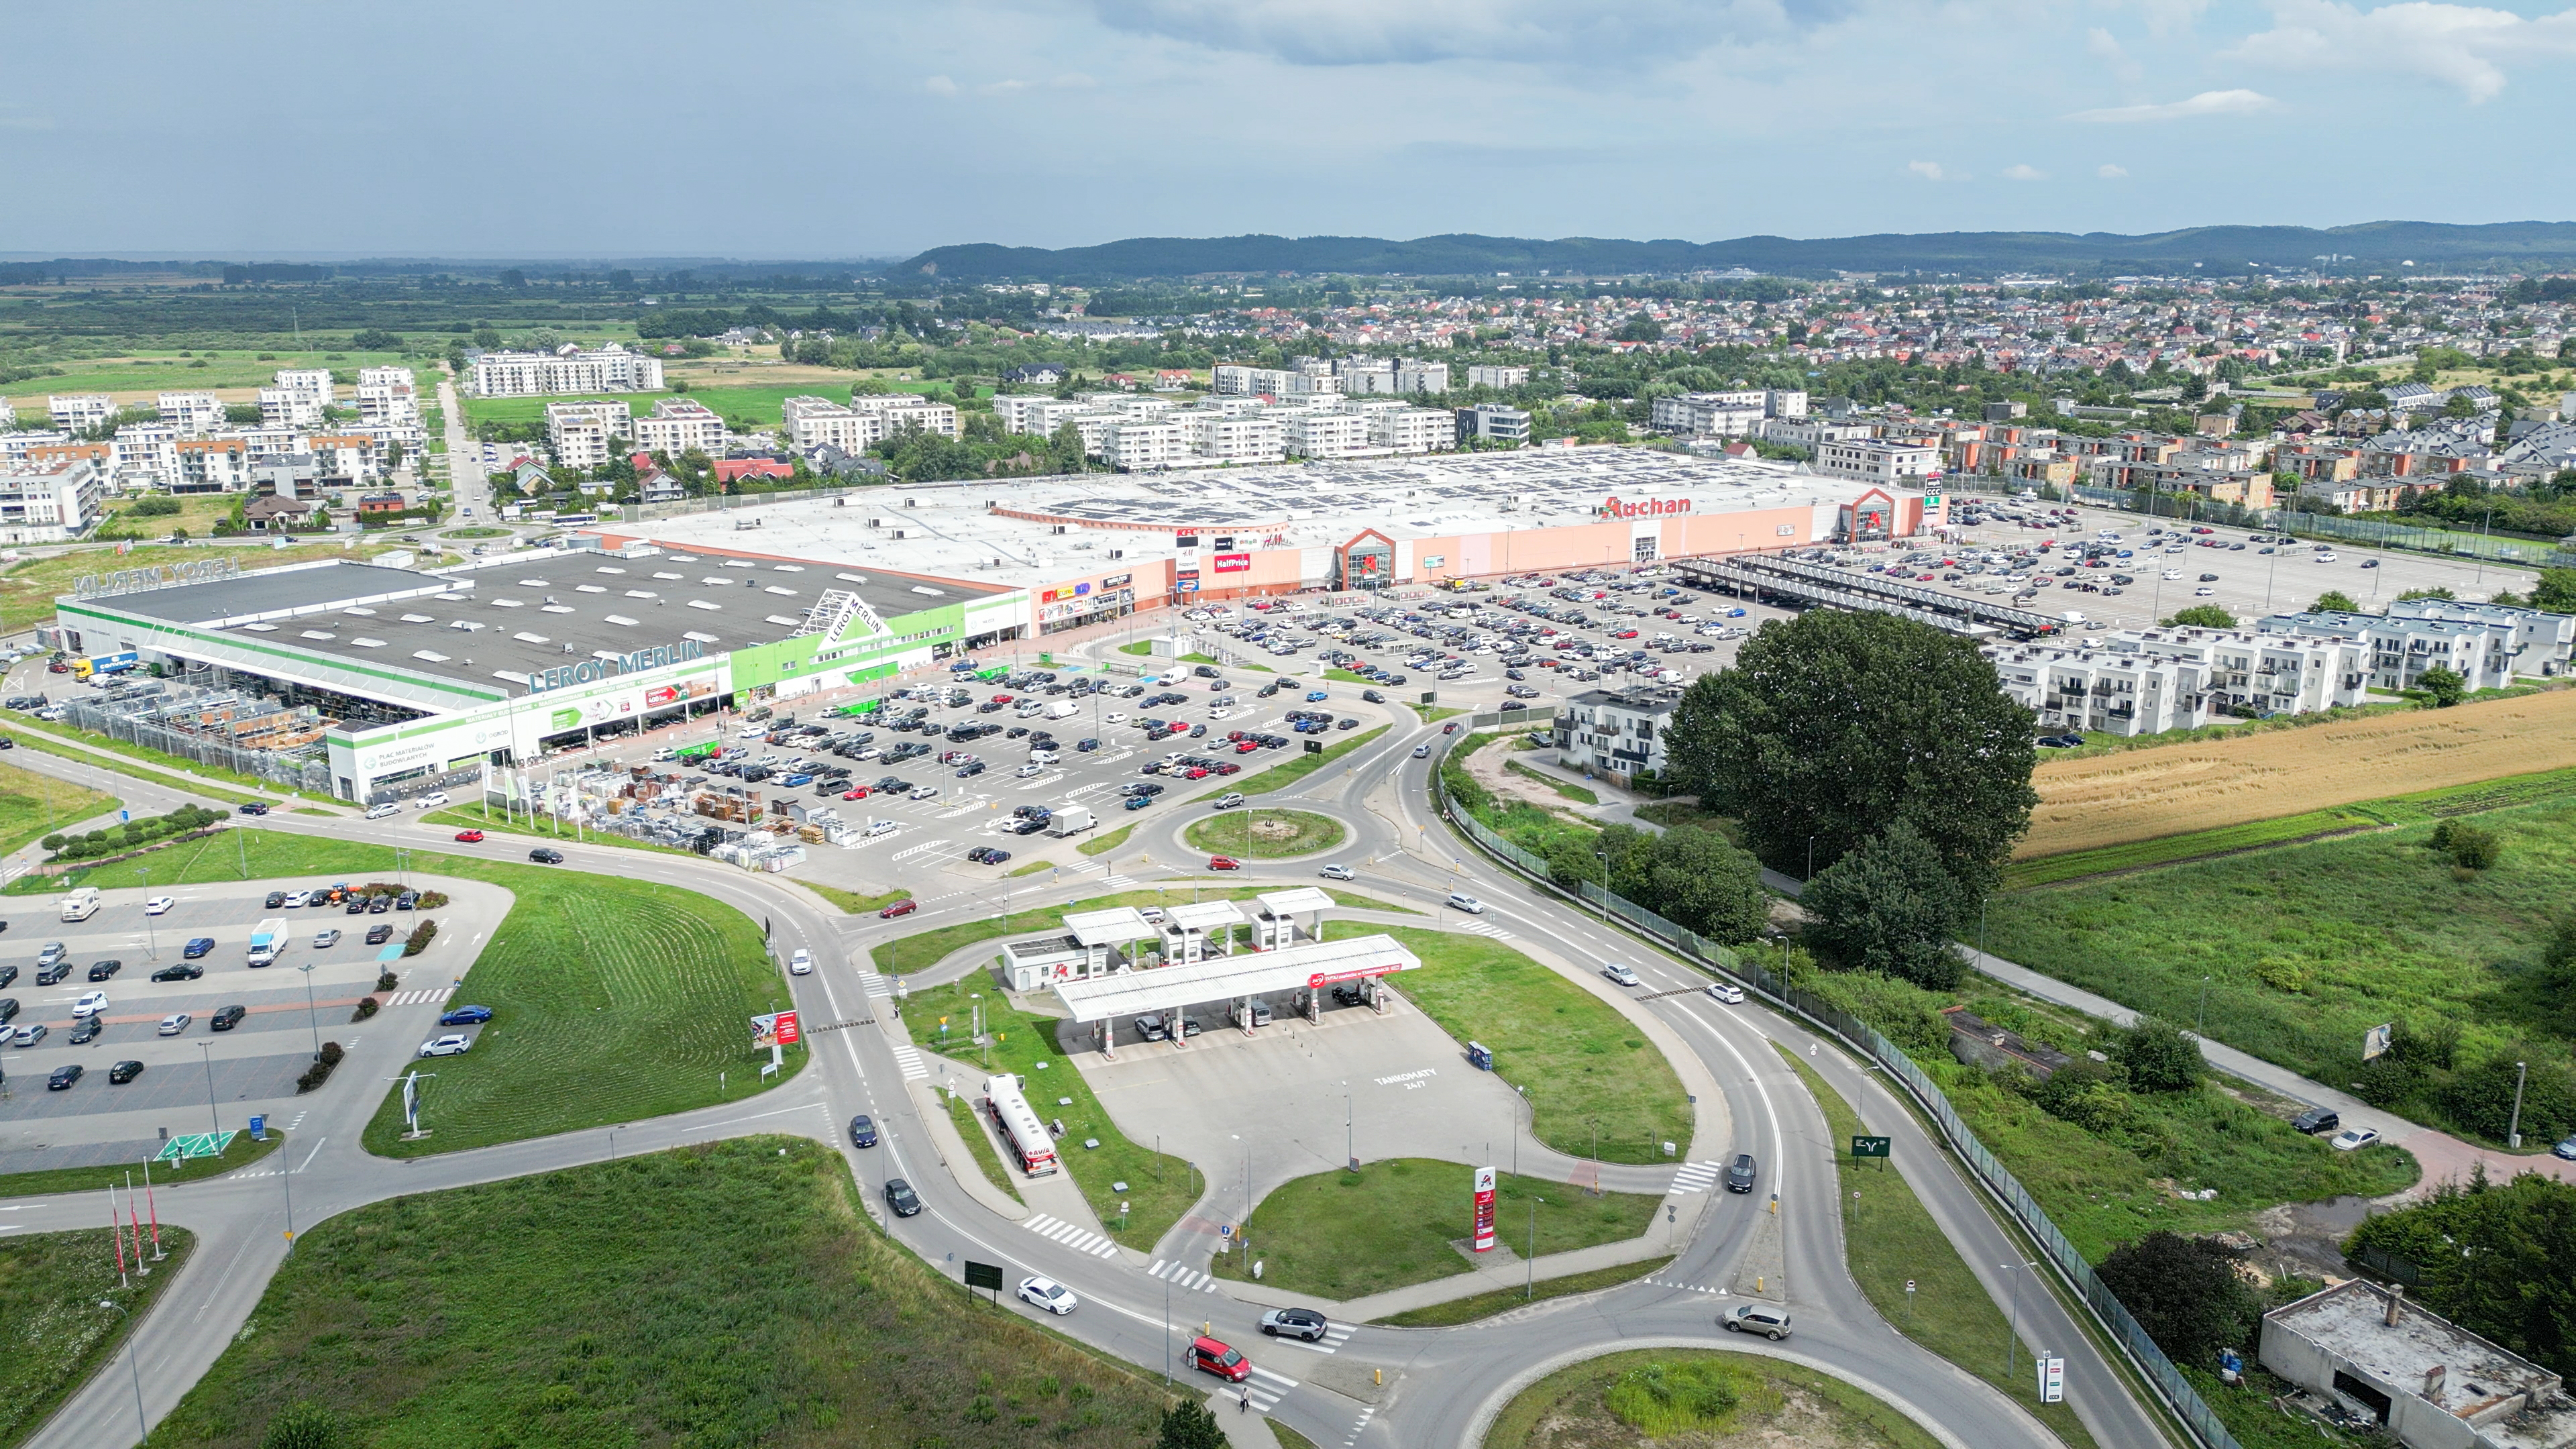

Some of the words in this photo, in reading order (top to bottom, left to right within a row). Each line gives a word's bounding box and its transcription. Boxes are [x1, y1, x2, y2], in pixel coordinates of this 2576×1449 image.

[1601, 496, 1690, 519] Auchan
[1177, 529, 1198, 537] KFC
[1217, 559, 1248, 568] HalfPrice
[1058, 588, 1075, 596] EURO
[830, 607, 853, 643] LEROY
[849, 598, 881, 633] MERLIN
[529, 658, 608, 694] LEROY
[617, 639, 704, 675] MERLIN
[379, 752, 394, 760] PLAC
[380, 752, 427, 767] BUDOWLANYCH
[1374, 1068, 1437, 1085] TANKOMATY
[1403, 1080, 1426, 1090] 24/7
[1033, 1147, 1051, 1156] AVIA
